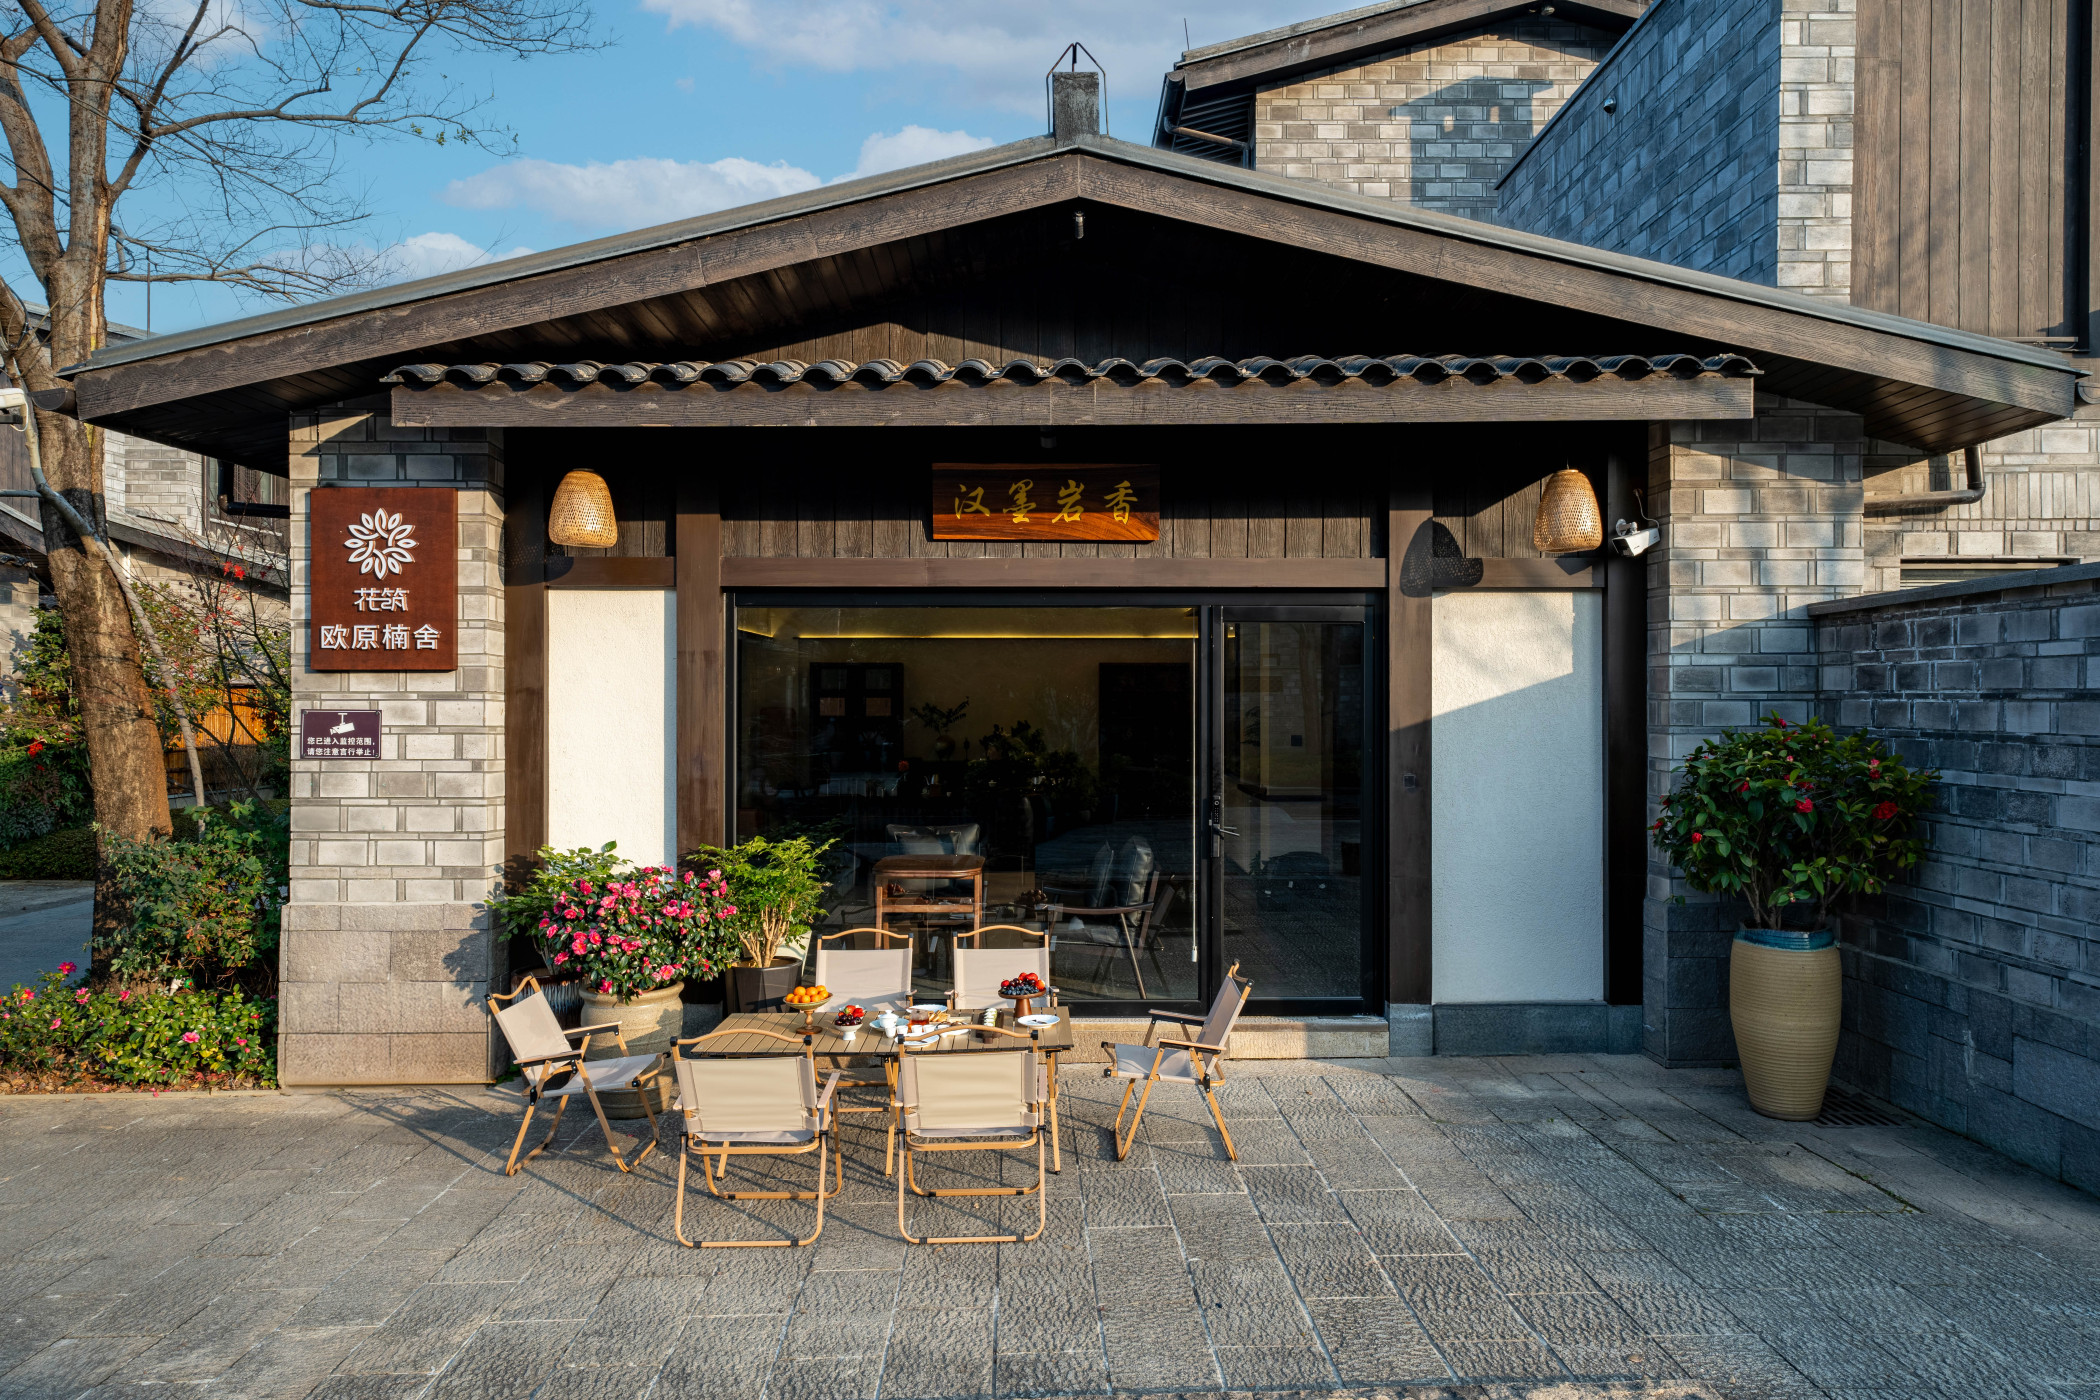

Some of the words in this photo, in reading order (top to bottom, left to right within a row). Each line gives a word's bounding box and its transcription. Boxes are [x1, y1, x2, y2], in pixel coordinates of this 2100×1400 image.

[353, 588, 409, 611] 花筑
[320, 624, 441, 650] 欧原楠舍
